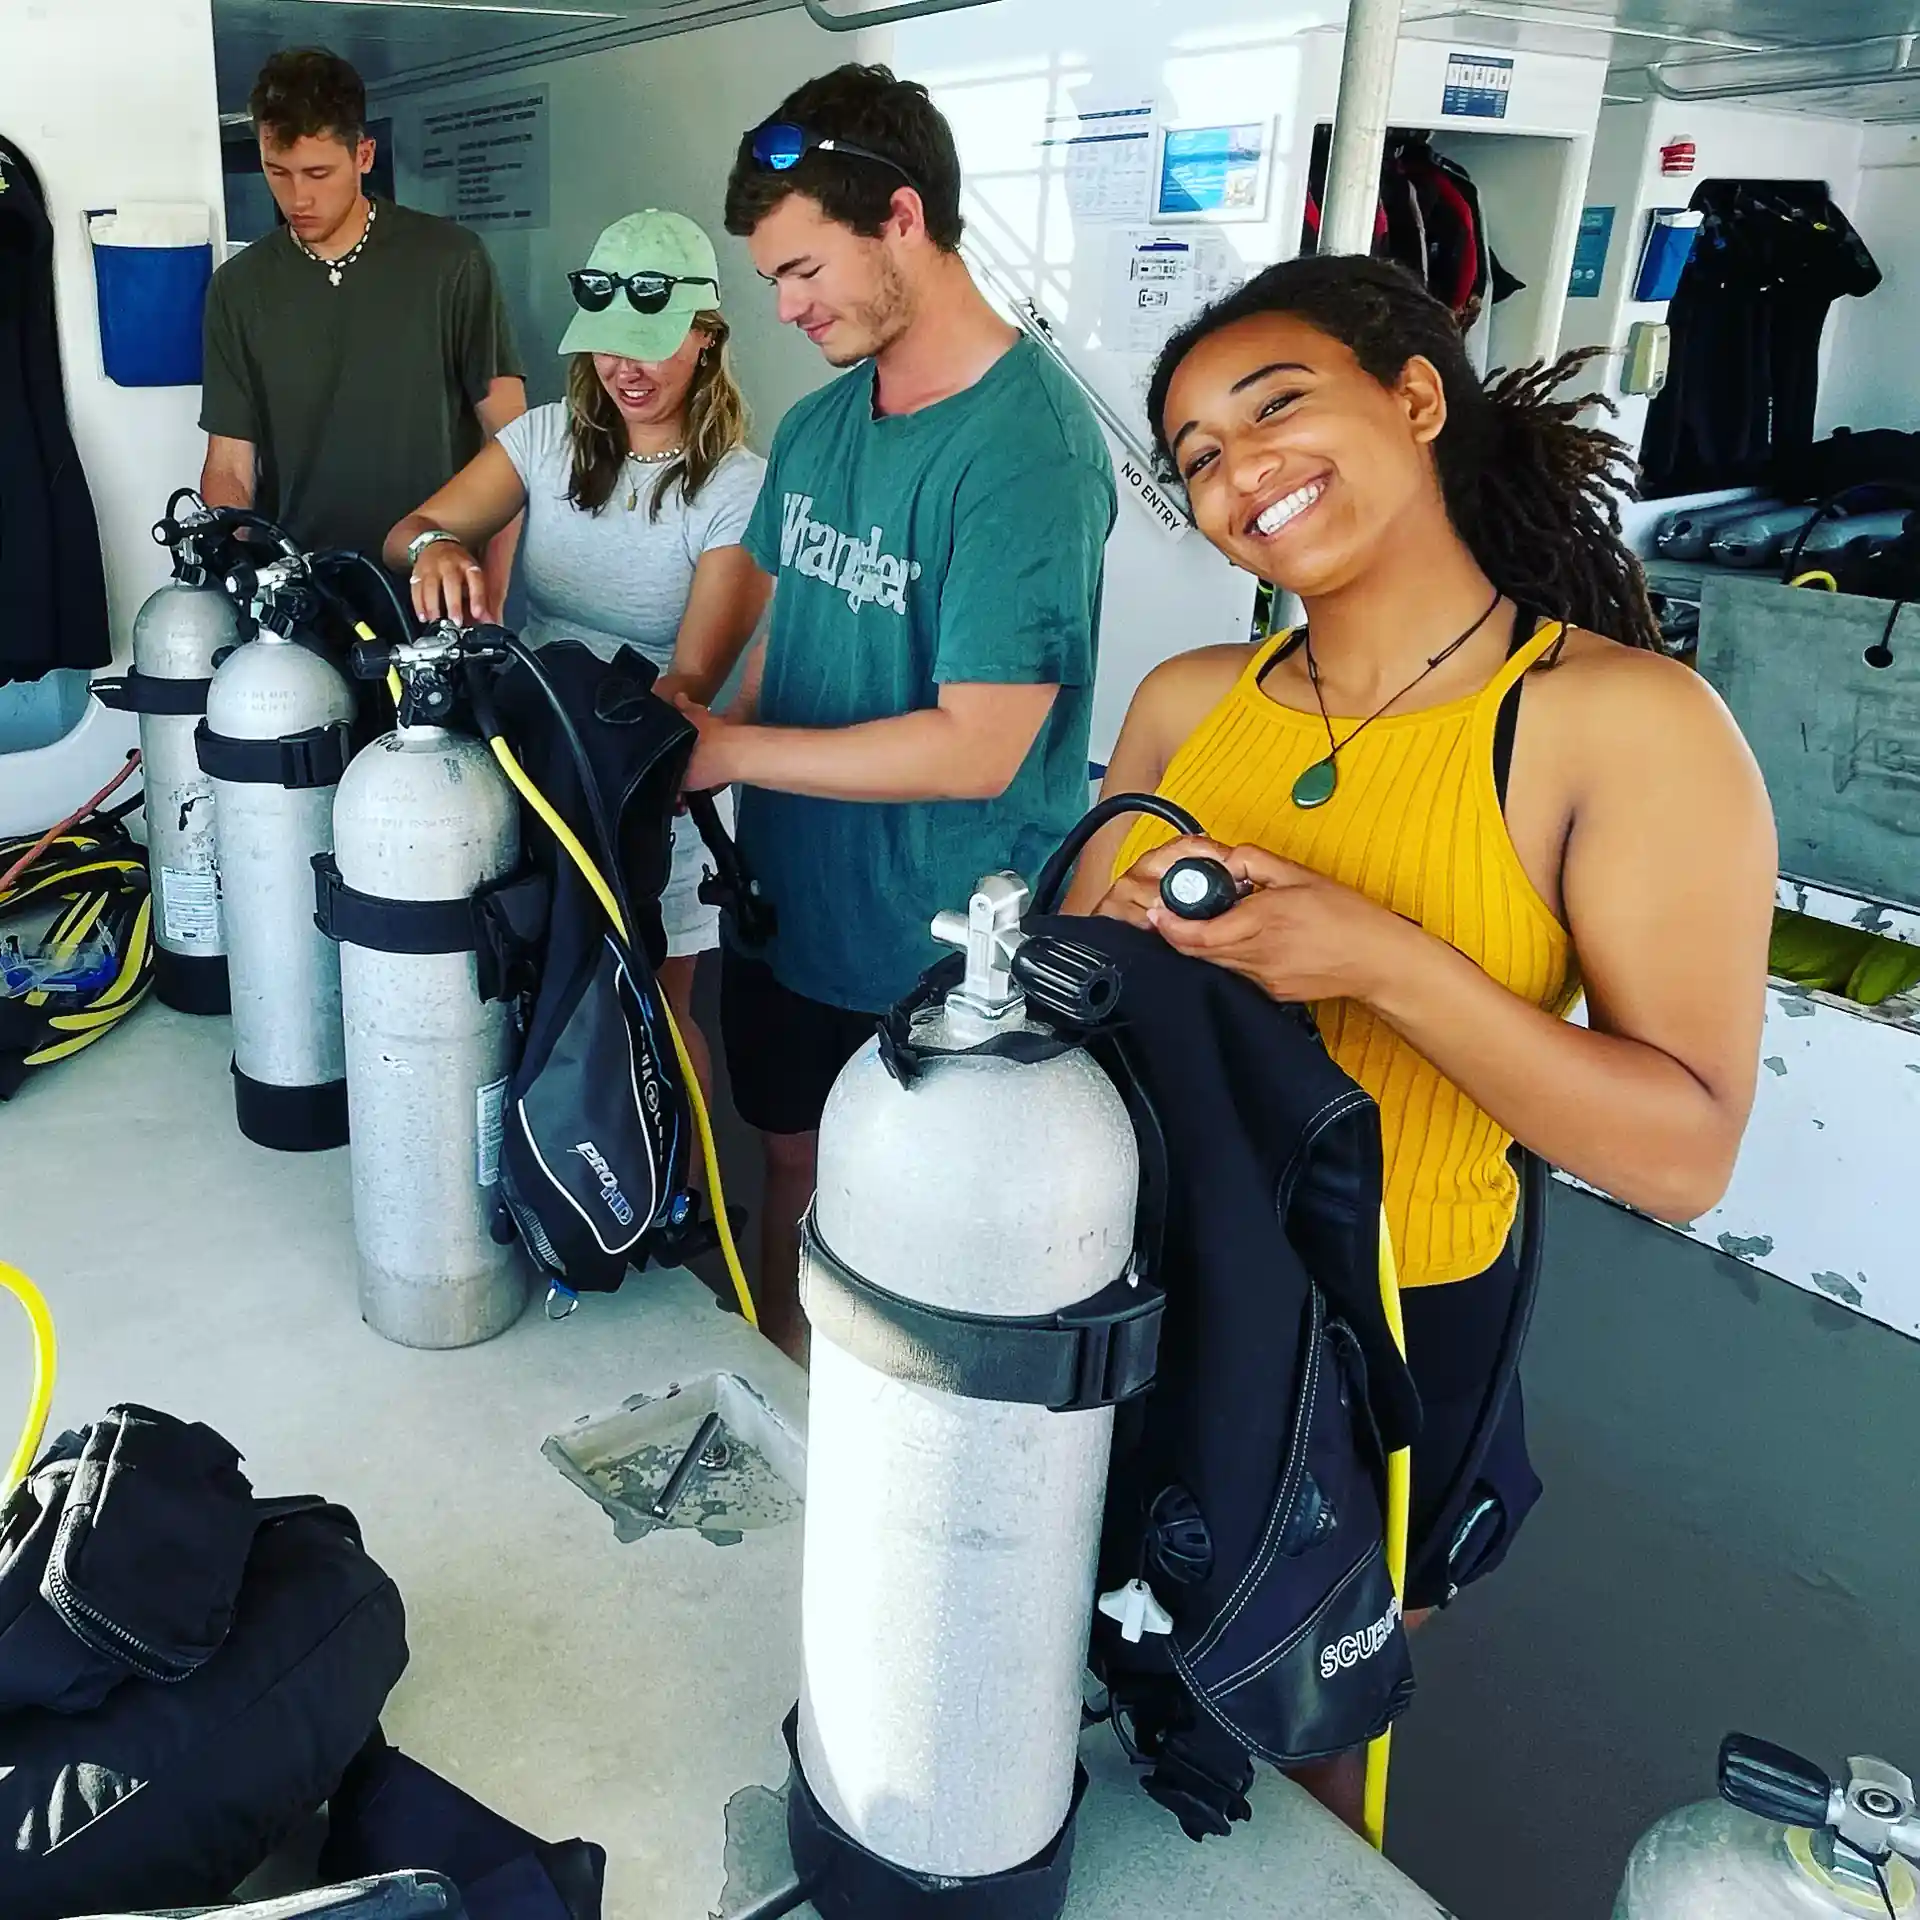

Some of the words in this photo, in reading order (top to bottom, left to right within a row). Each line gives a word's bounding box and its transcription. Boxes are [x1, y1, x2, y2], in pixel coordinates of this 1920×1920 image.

[1120, 461, 1142, 486] NO
[1140, 484, 1181, 531] ENTRY
[781, 492, 910, 615] Wrangler
